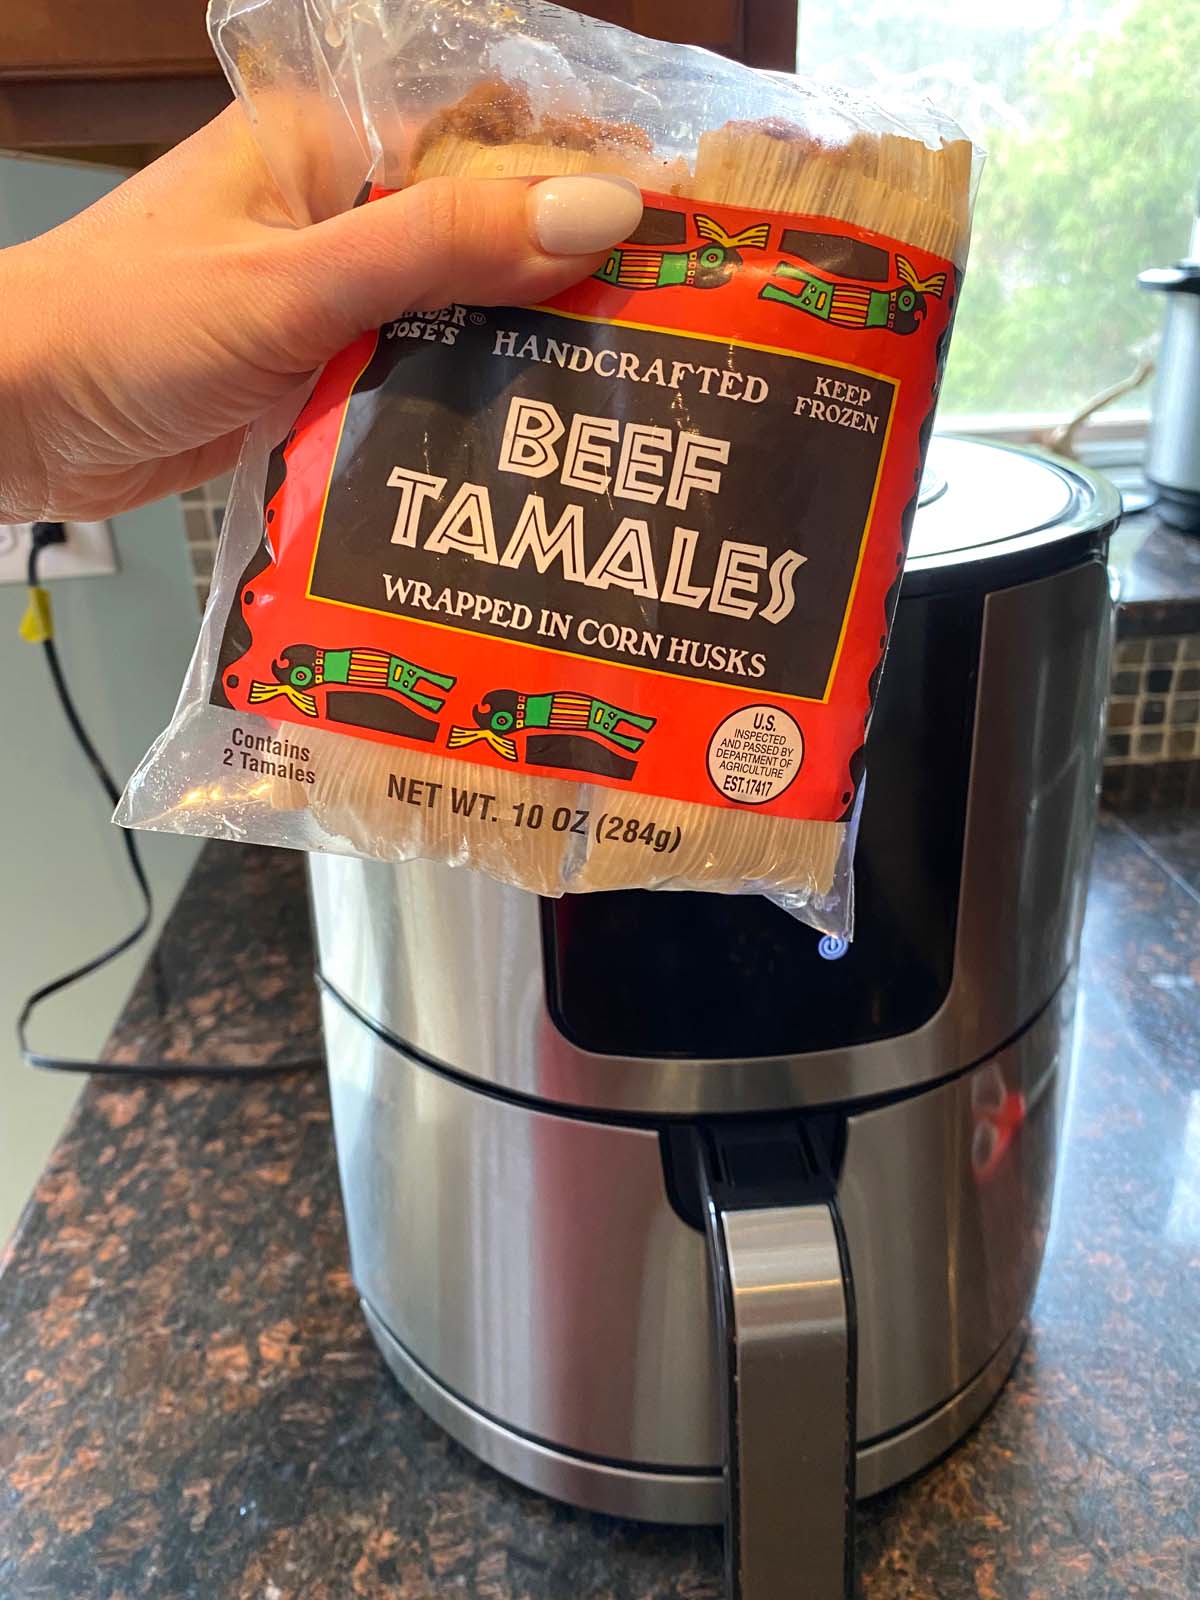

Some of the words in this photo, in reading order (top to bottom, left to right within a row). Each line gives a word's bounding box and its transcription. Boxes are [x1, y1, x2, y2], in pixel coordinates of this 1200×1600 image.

[386, 321, 460, 346] JOSÉ'S
[492, 329, 769, 404] HANDCRAFTED
[814, 376, 872, 408] KEEP
[793, 395, 879, 434] FROZEN
[498, 396, 731, 511] BEEF
[386, 466, 808, 625] TAMALES
[382, 573, 534, 630] WRAPPED
[537, 608, 573, 640] IN
[576, 618, 662, 662] CORN
[667, 638, 767, 679] HUSKS
[232, 727, 311, 762] Contains
[720, 738, 741, 749] AND
[743, 742, 779, 755] PASSED
[780, 747, 794, 758] BY
[735, 729, 786, 745] INSPECTED
[223, 749, 234, 766] 2
[239, 750, 316, 785] Tamales
[716, 748, 779, 766] DEPARTMENT
[779, 758, 793, 769] OF
[719, 760, 784, 778] AGRICULTURE
[723, 775, 772, 796] EST.17417
[387, 773, 442, 809] NET
[450, 786, 498, 823] WT.
[511, 802, 544, 830] 10
[551, 806, 590, 836] OZ
[595, 813, 683, 854] (284g)
